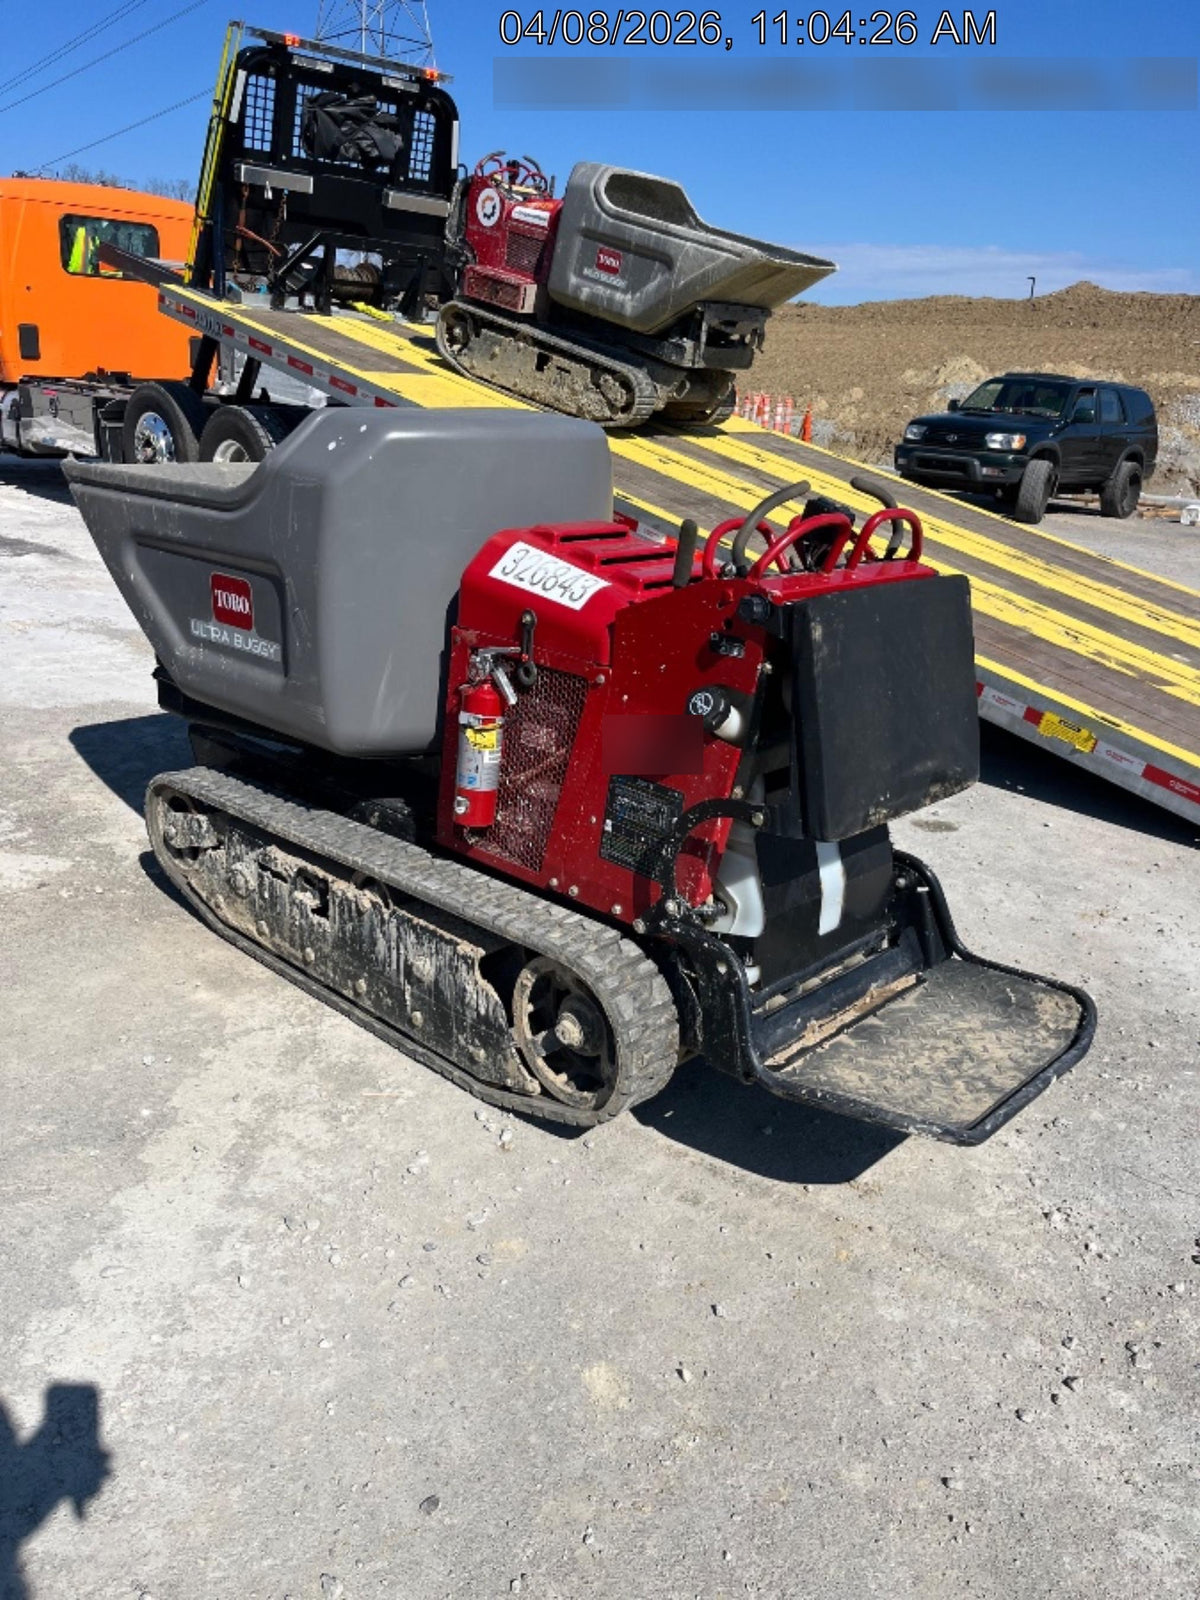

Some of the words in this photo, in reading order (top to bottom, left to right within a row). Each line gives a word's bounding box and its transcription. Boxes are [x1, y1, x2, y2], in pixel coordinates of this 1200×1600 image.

[501, 548, 599, 602] 326843
[214, 588, 250, 615] TORO
[191, 618, 230, 643] ULTRA
[233, 632, 280, 660] BUGGY
